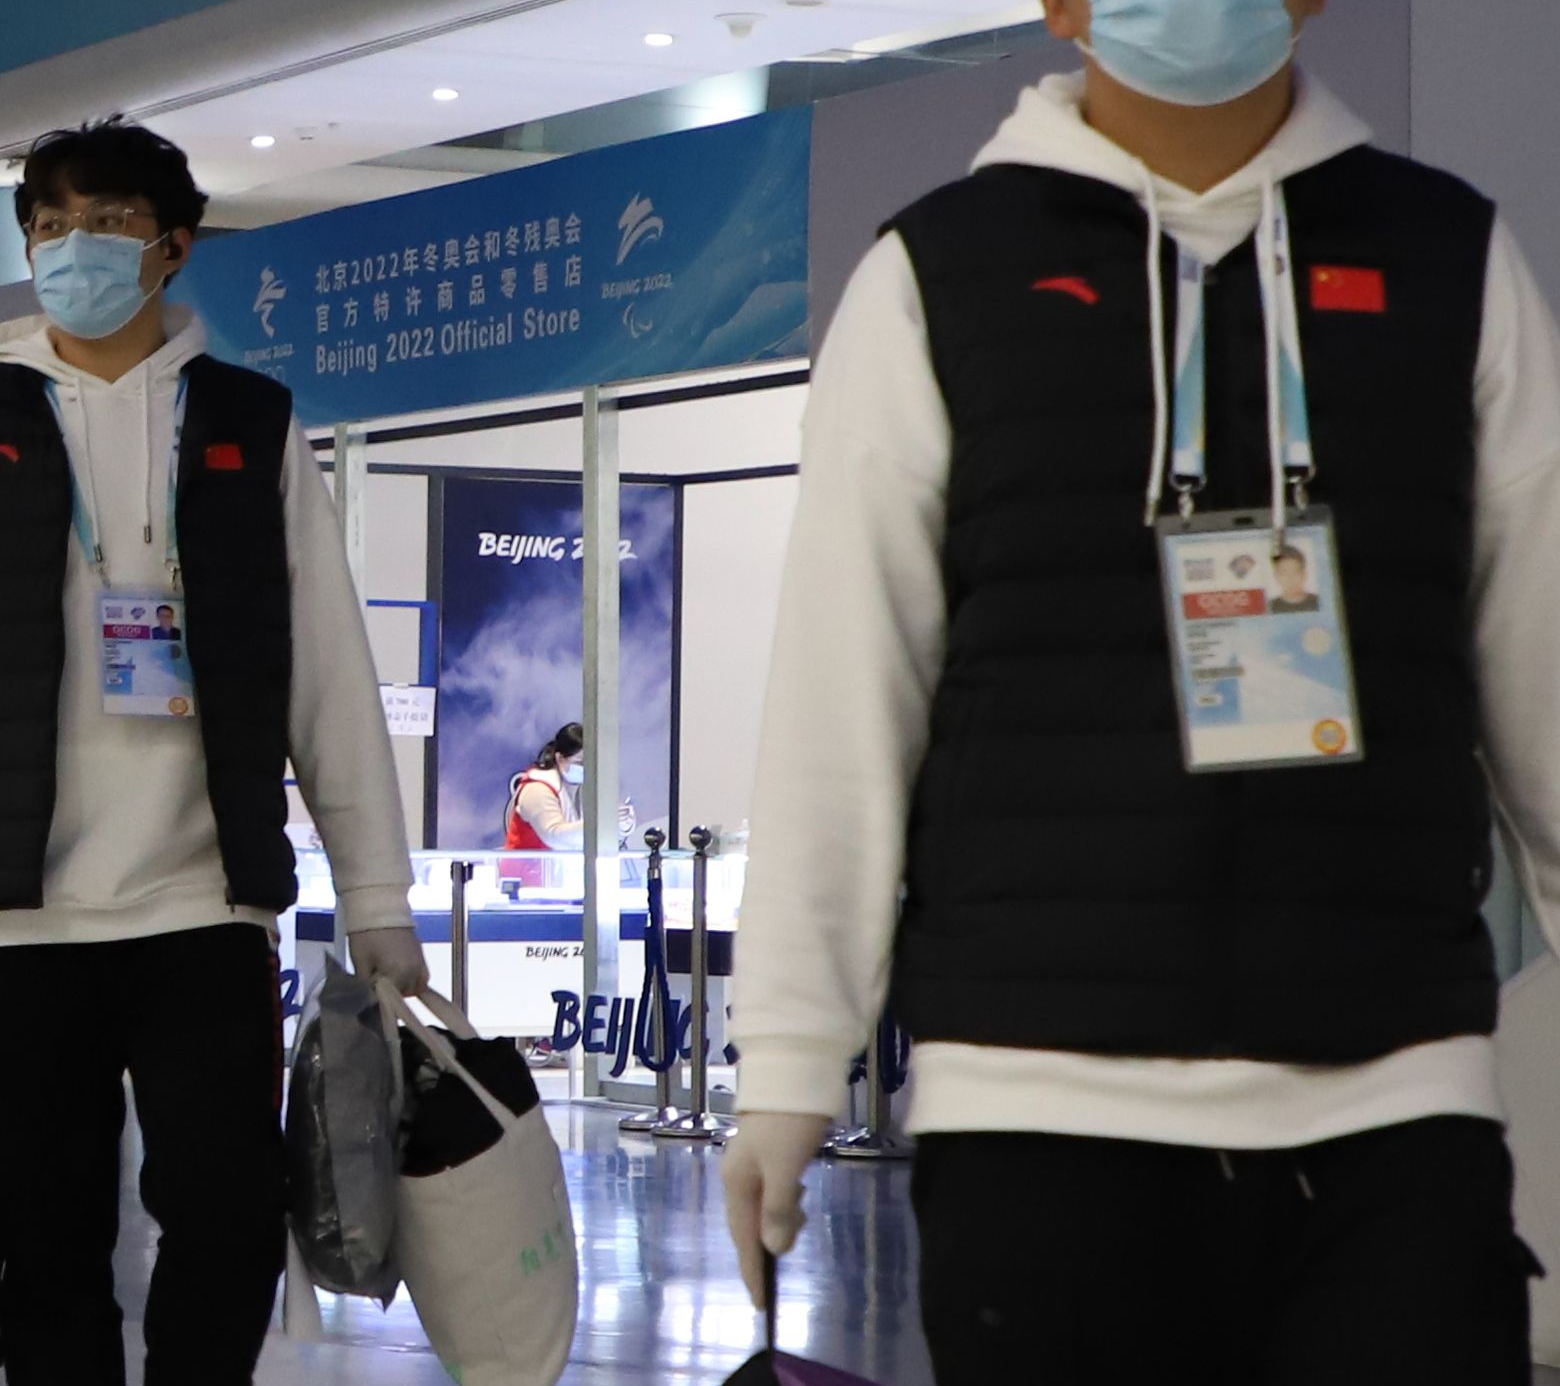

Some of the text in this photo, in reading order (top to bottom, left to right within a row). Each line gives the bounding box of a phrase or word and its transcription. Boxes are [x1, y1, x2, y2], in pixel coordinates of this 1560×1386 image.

[315, 213, 581, 293] 北京2022年冬奥会和冬残奥会
[315, 254, 581, 333] 官方特许商品零售店
[315, 307, 580, 376] Beijing 2022 Official Store
[478, 532, 638, 565] BEIJING 22
[526, 946, 568, 961] BEIJING
